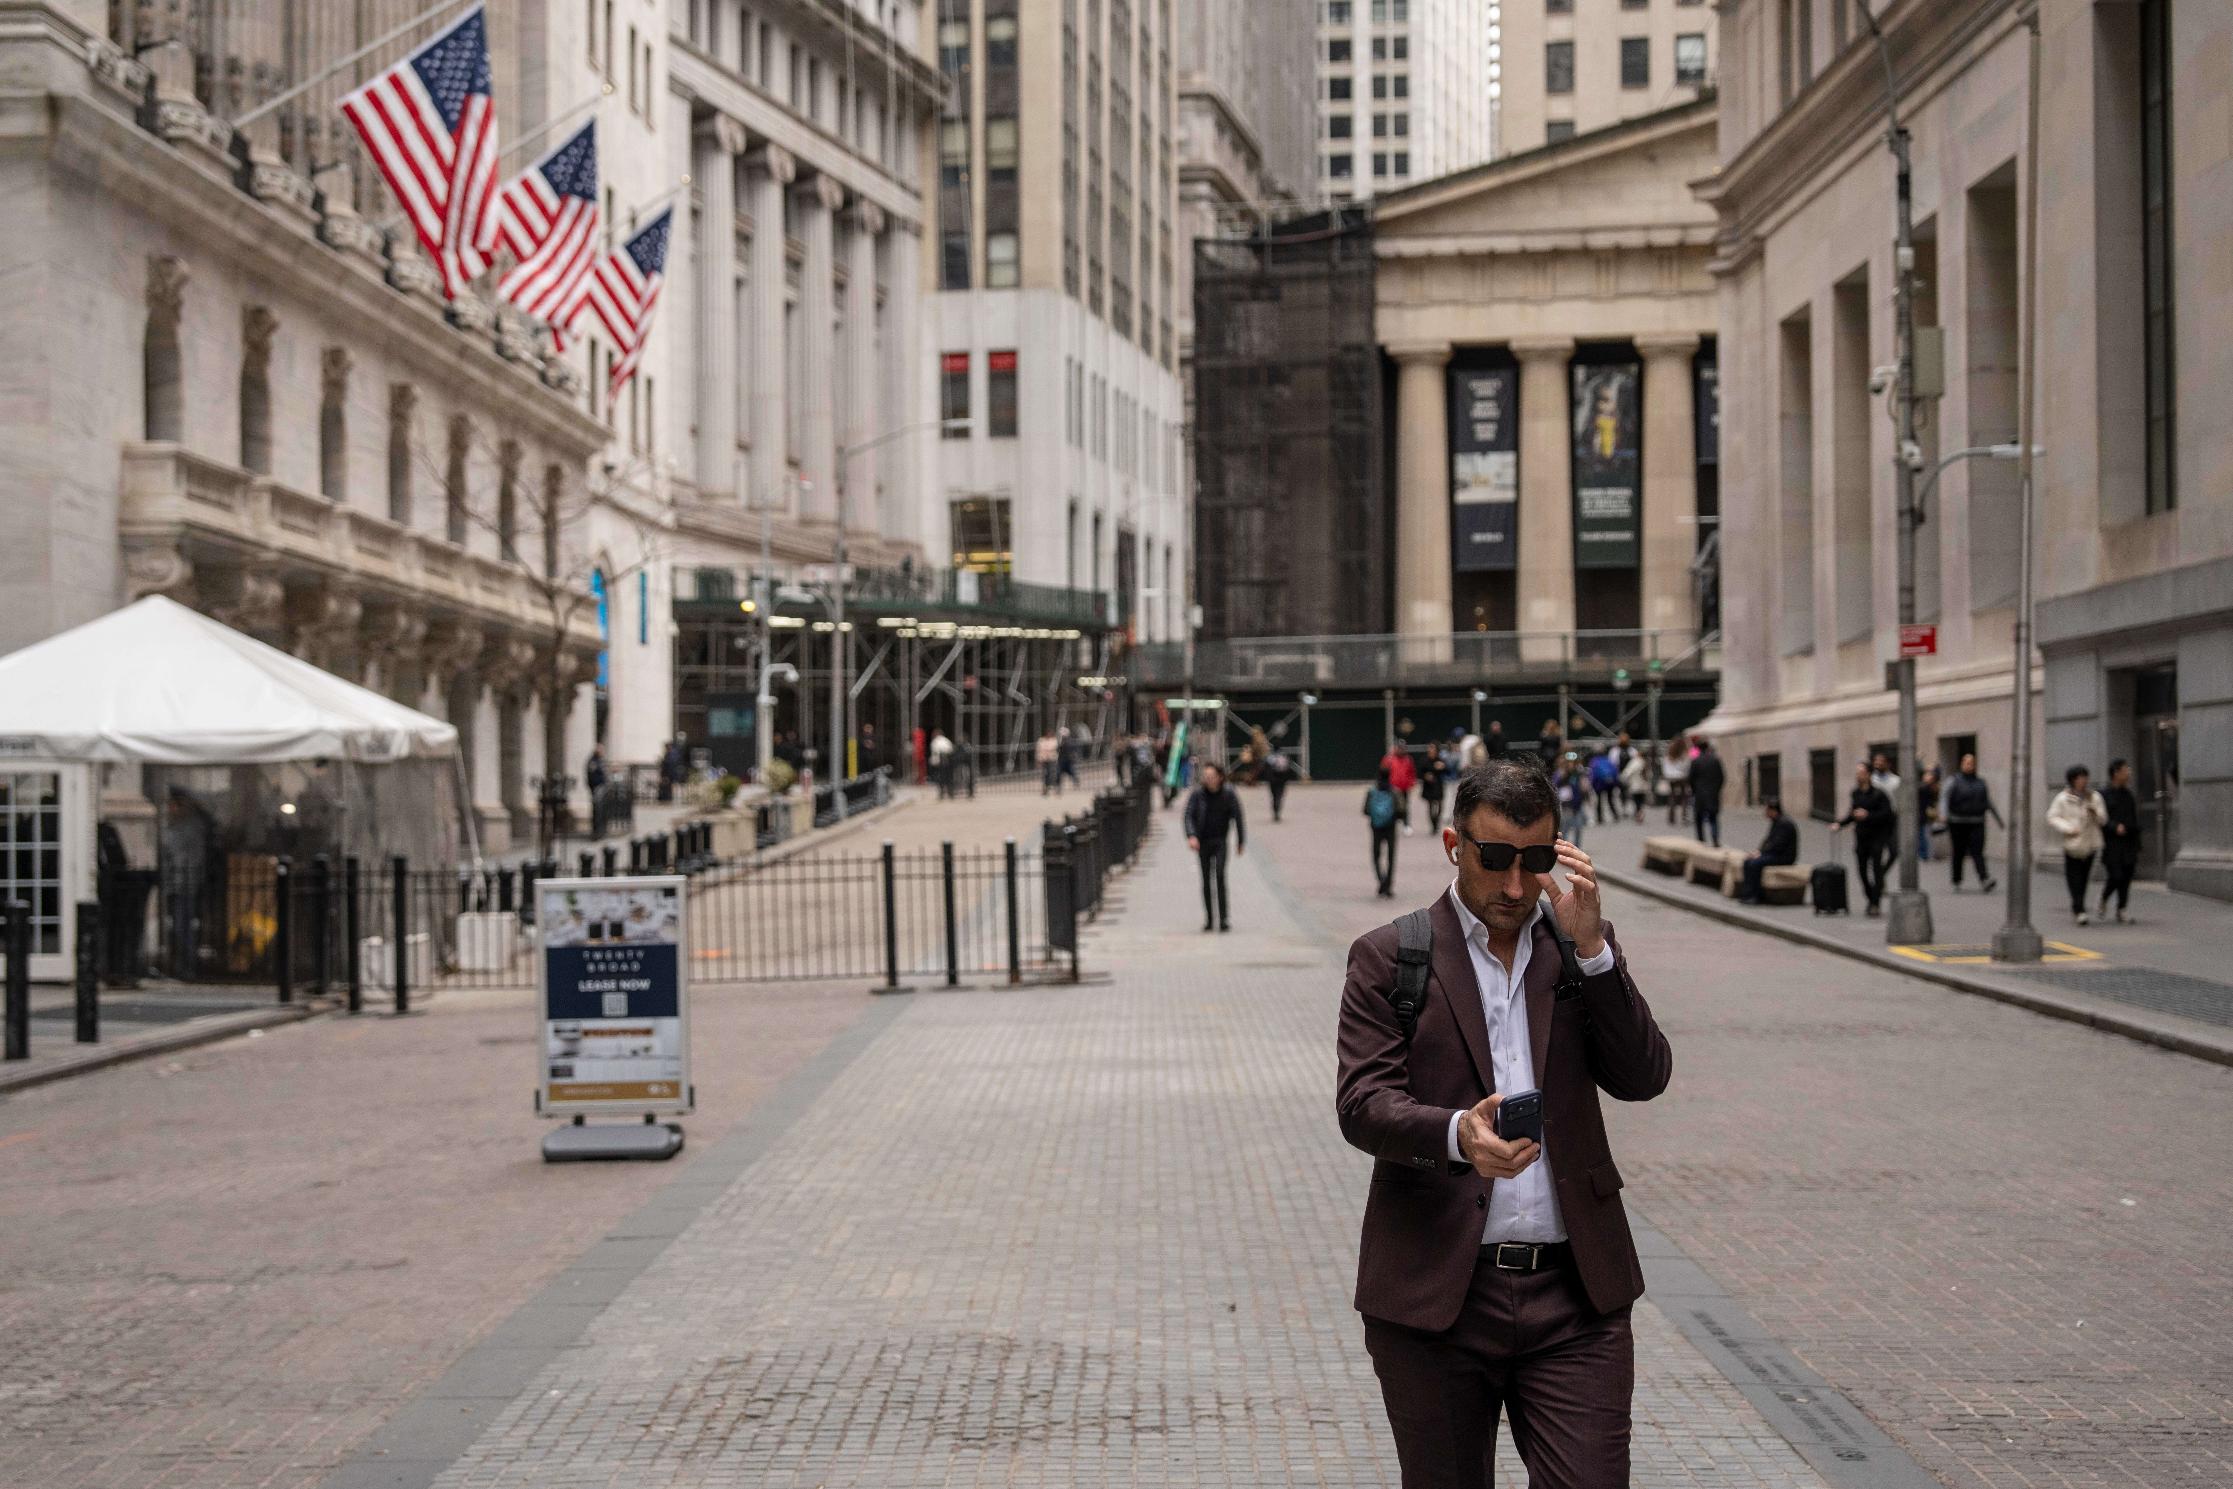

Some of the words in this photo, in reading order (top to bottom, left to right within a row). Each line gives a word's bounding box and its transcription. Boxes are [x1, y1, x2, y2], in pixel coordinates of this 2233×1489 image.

[586, 961, 641, 973] BROAD
[578, 979, 617, 992] LEASE
[619, 978, 651, 991] NOW
